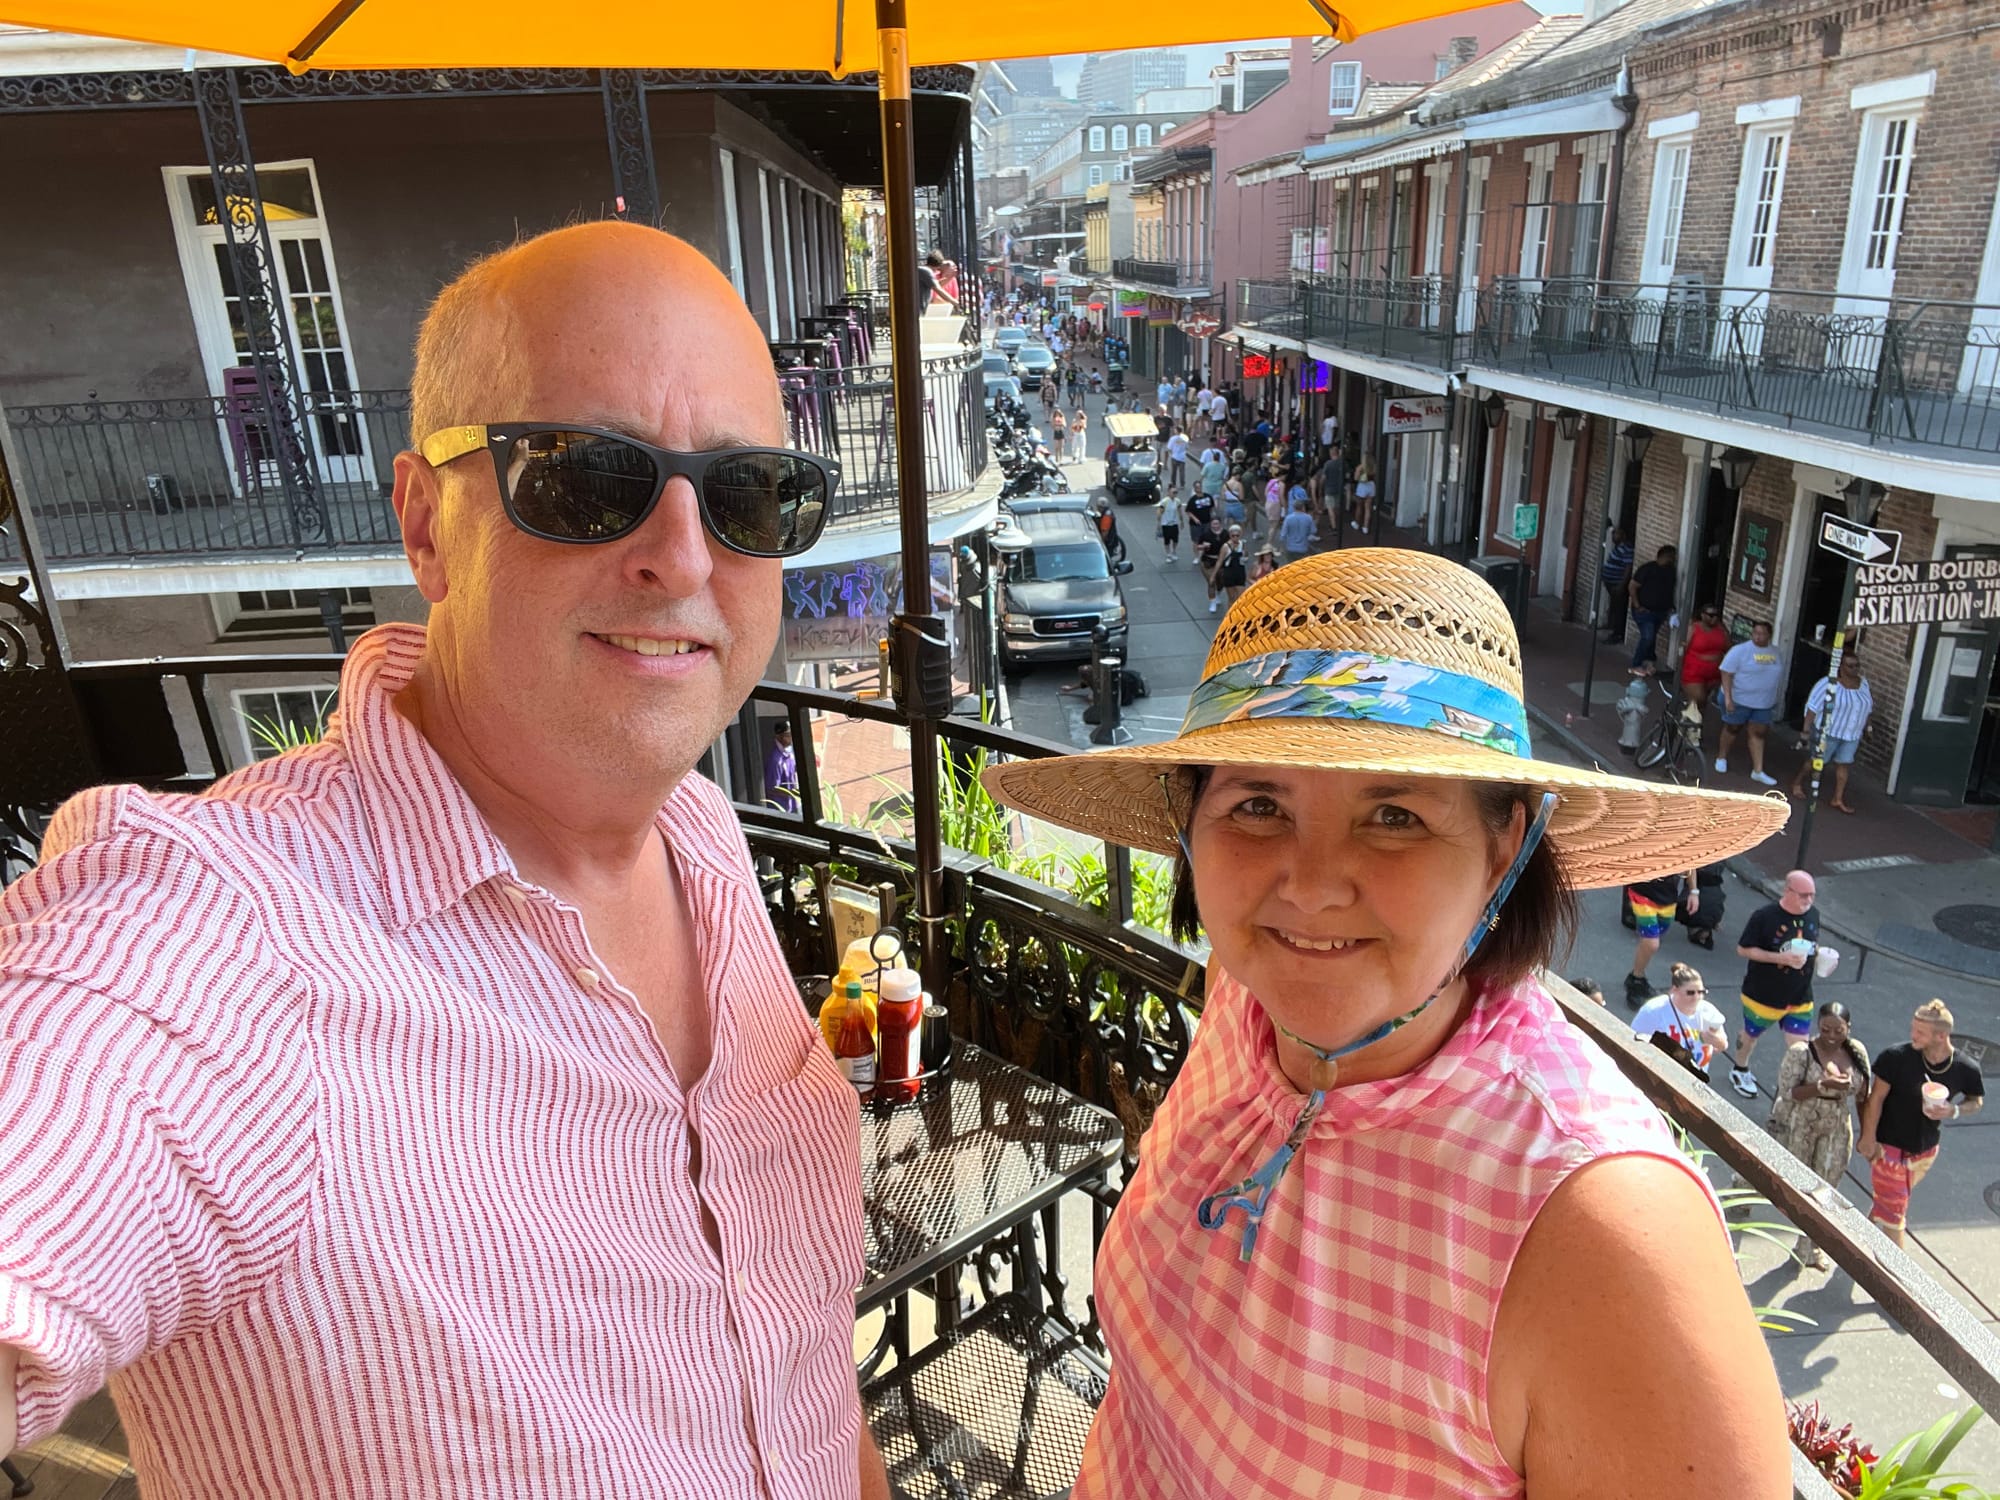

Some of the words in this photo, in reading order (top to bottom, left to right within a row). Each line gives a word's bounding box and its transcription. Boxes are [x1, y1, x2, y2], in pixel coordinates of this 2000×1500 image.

[1827, 526, 1845, 543] ONE
[1846, 531, 1866, 550] WAY
[1929, 559, 2000, 581] BOURB
[1859, 582, 1940, 597] DEDICATED
[1947, 580, 1967, 591] TO
[1976, 578, 2000, 590] THE
[1846, 591, 1973, 626] ESERVATION
[1055, 621, 1079, 629] GMC
